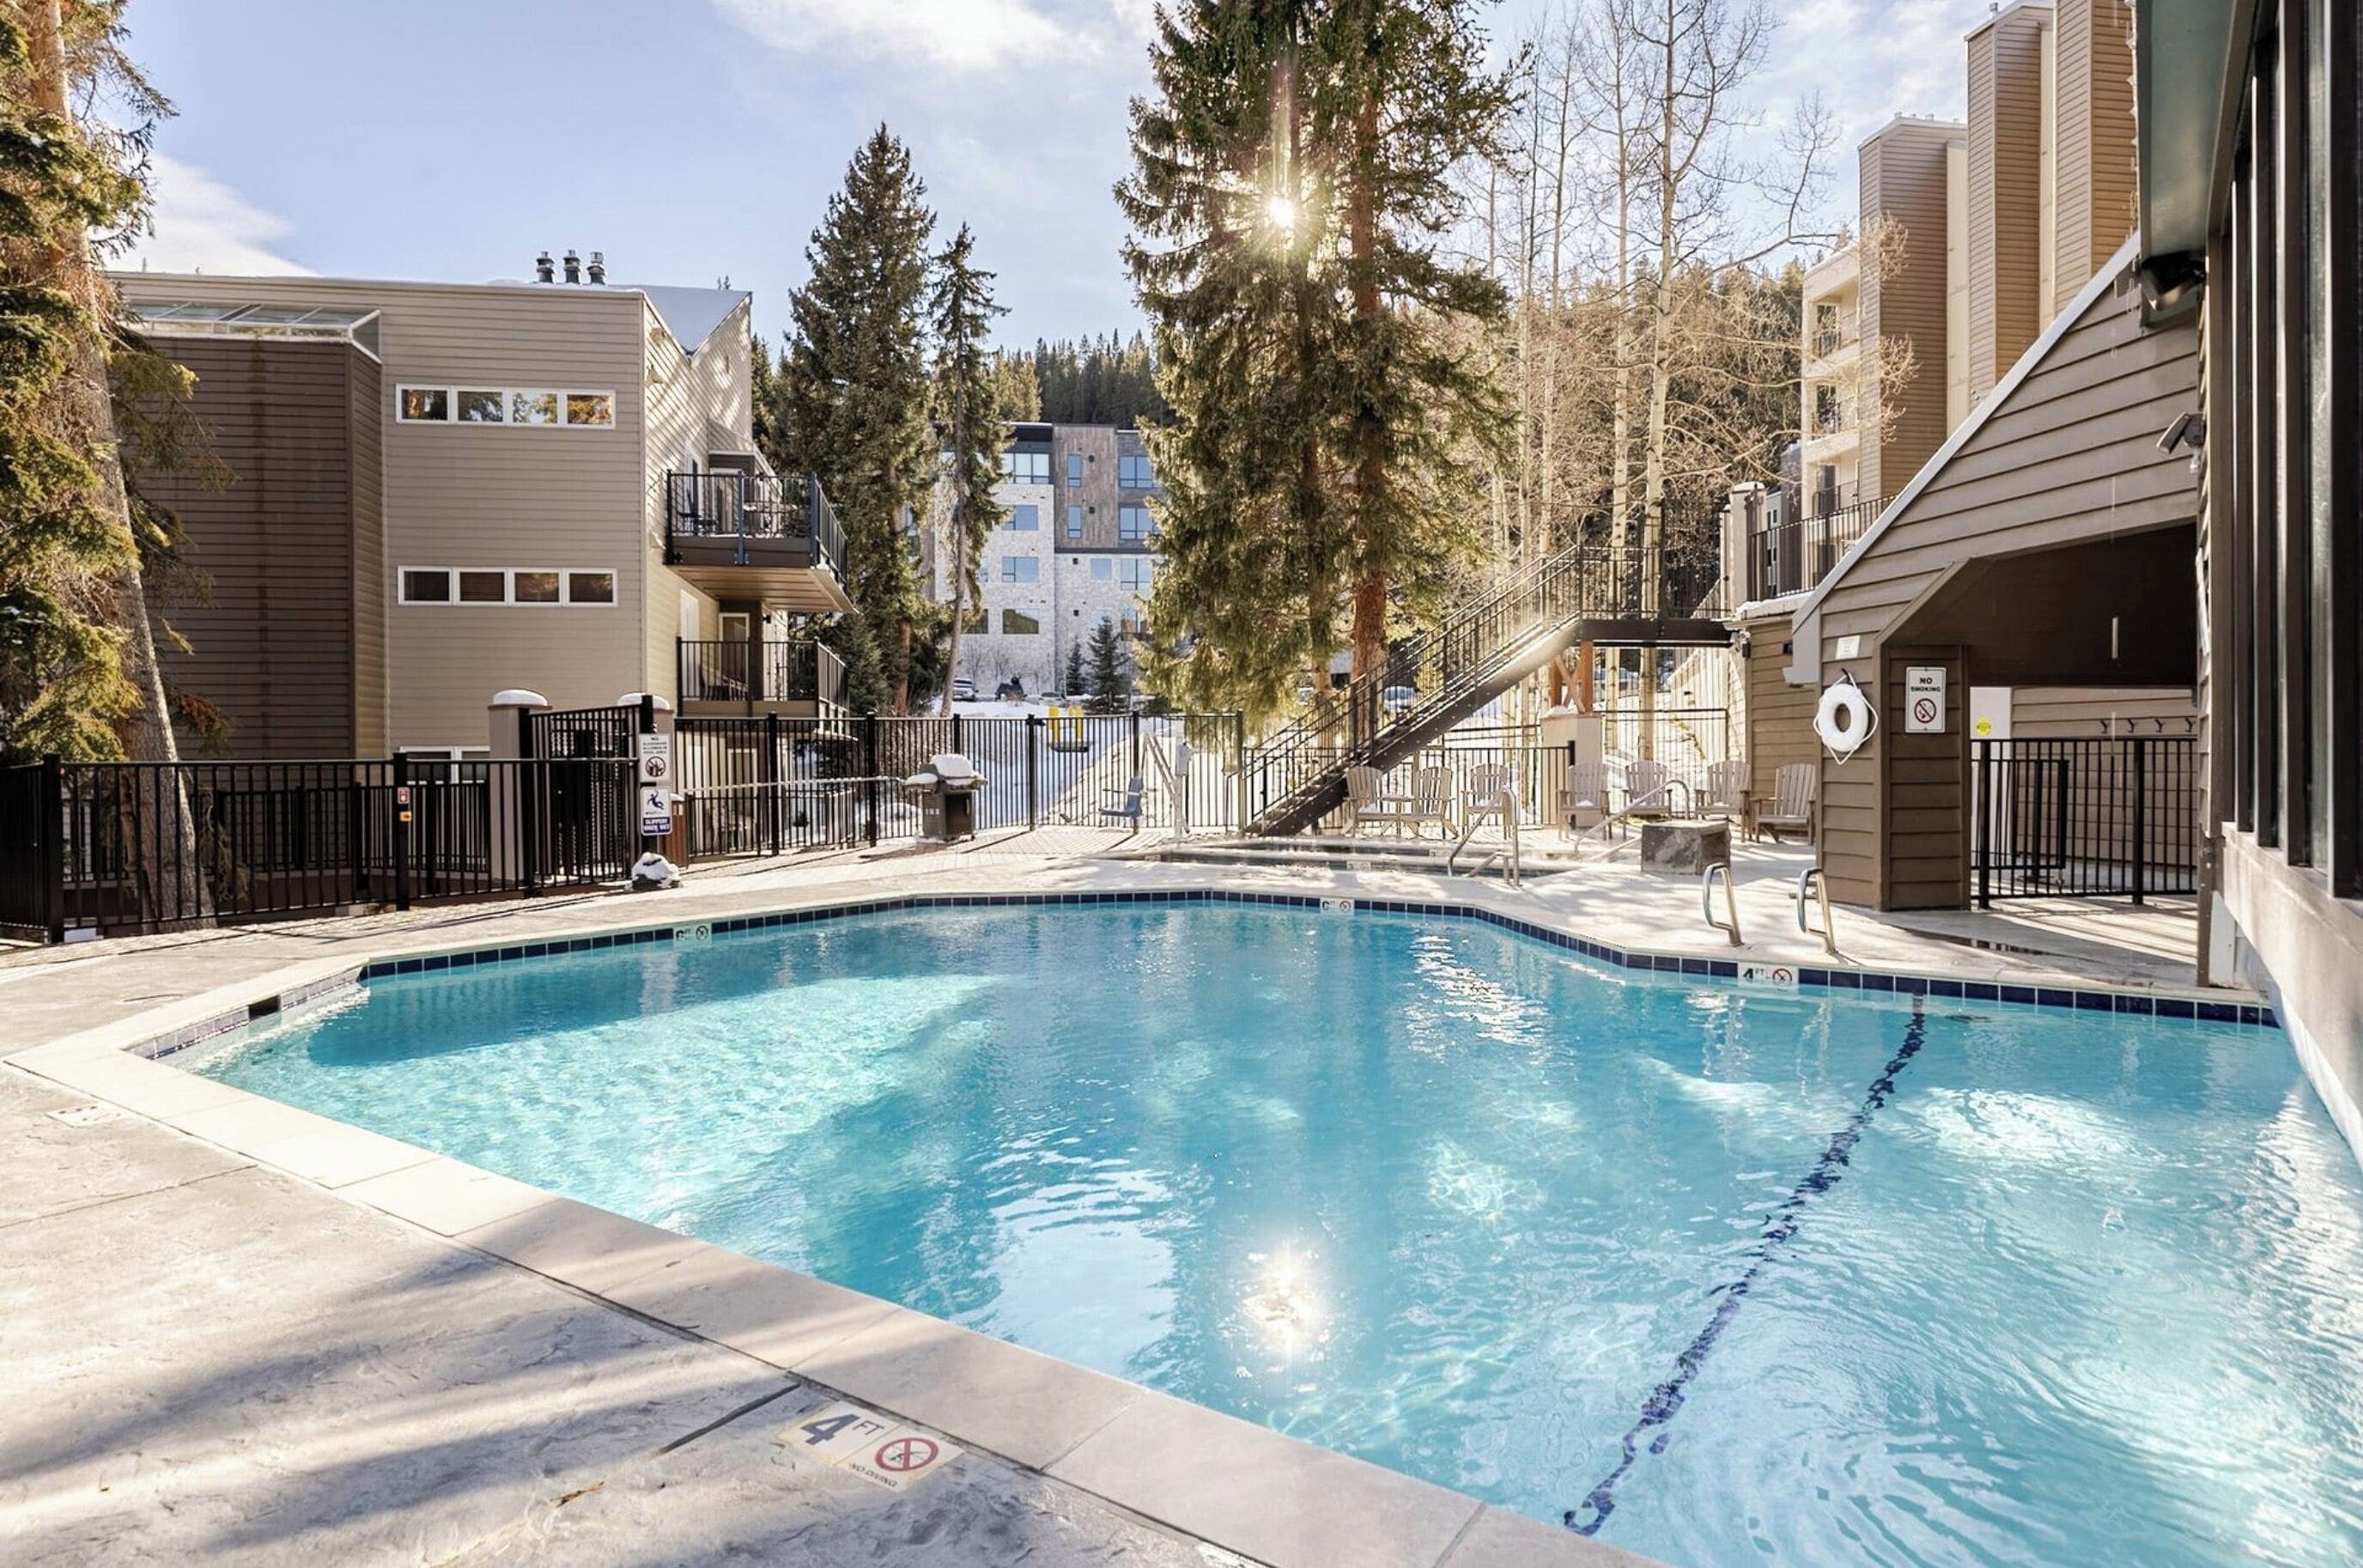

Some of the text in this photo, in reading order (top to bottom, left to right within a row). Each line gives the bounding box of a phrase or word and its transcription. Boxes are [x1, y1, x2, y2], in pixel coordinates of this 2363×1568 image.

[800, 1413, 885, 1445] 4 FT
[849, 1462, 898, 1487] NO DIVING
